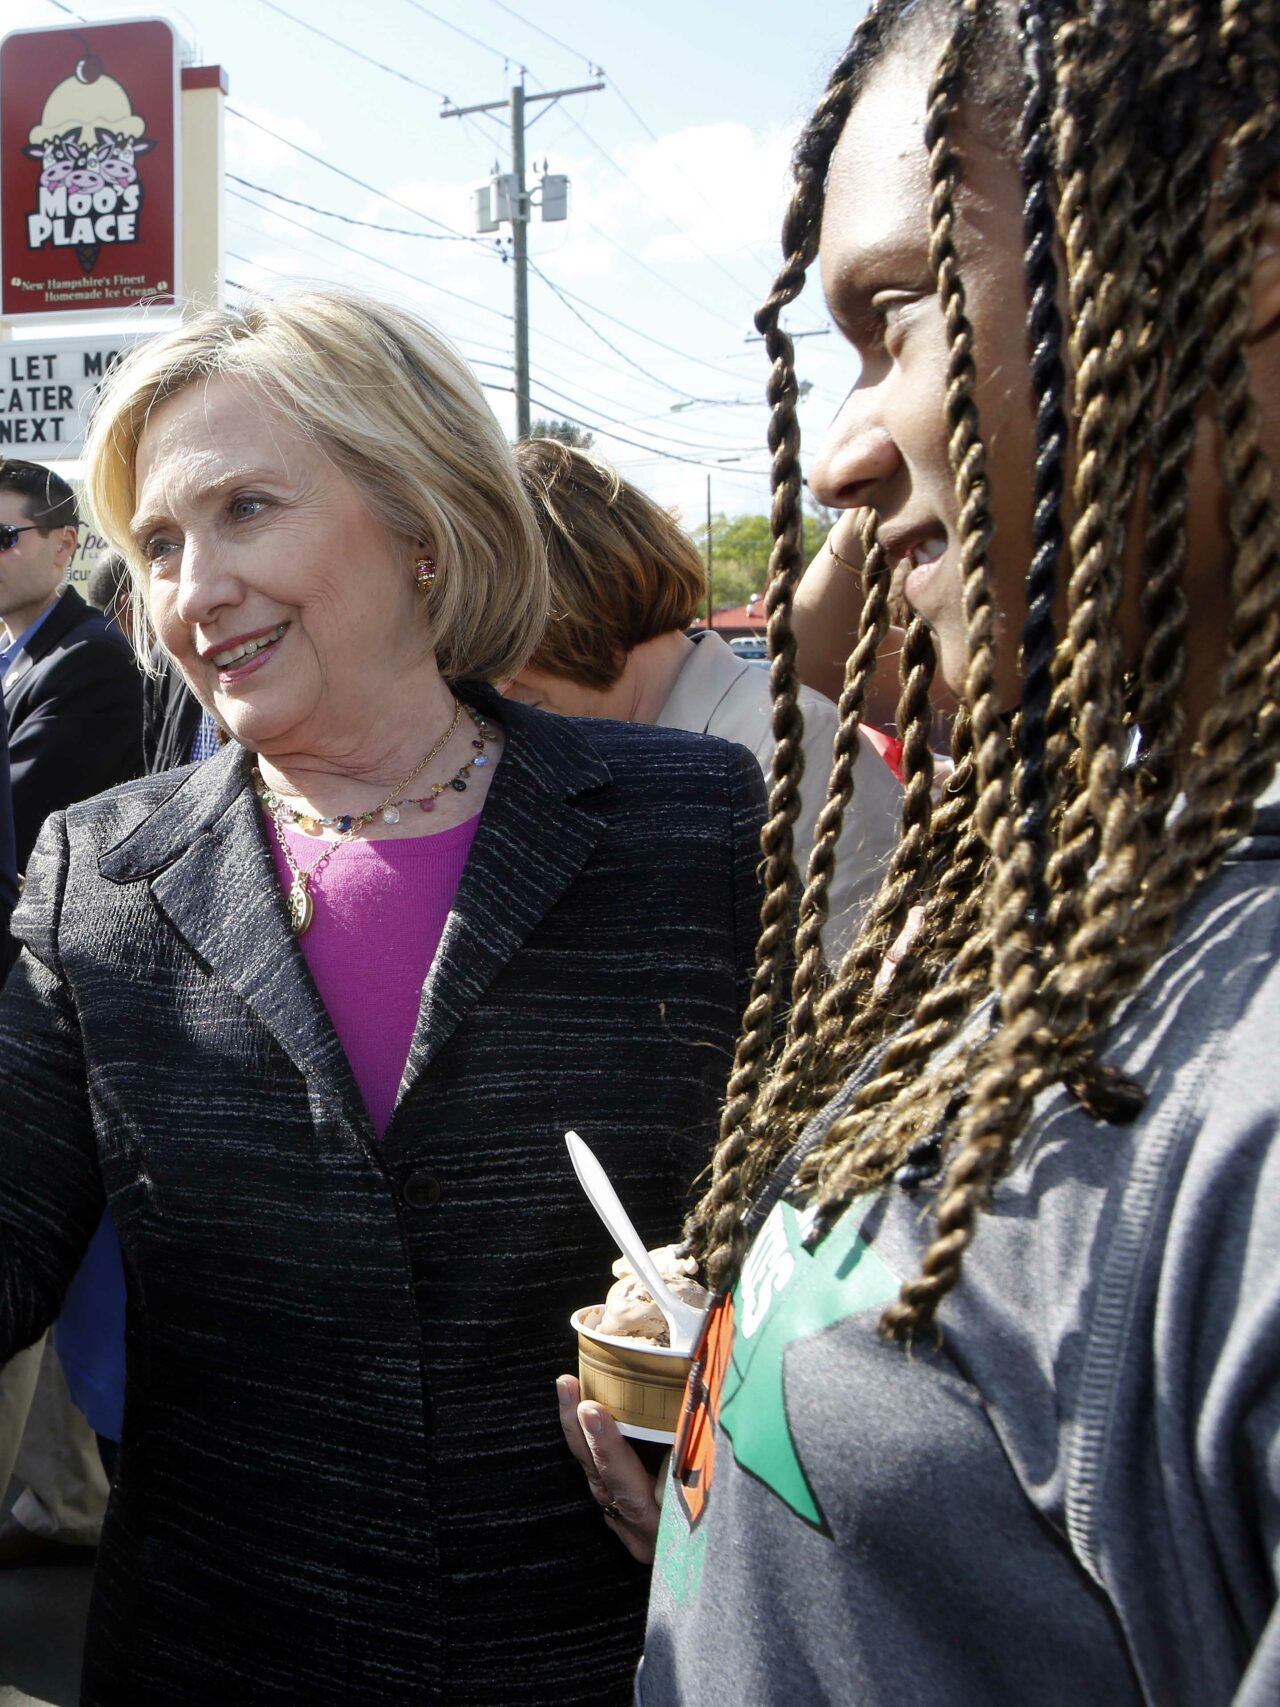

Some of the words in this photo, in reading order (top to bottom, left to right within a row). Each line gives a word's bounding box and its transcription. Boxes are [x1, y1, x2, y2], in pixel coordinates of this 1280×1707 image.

[39, 184, 140, 218] MOO'S
[28, 213, 136, 248] PLACE
[22, 280, 45, 291] New
[47, 276, 111, 290] Hampshire's
[114, 274, 145, 285] Finest
[45, 288, 102, 302] Homemade
[105, 288, 121, 298] Ice
[123, 287, 157, 297] Cream
[11, 355, 57, 381] LET
